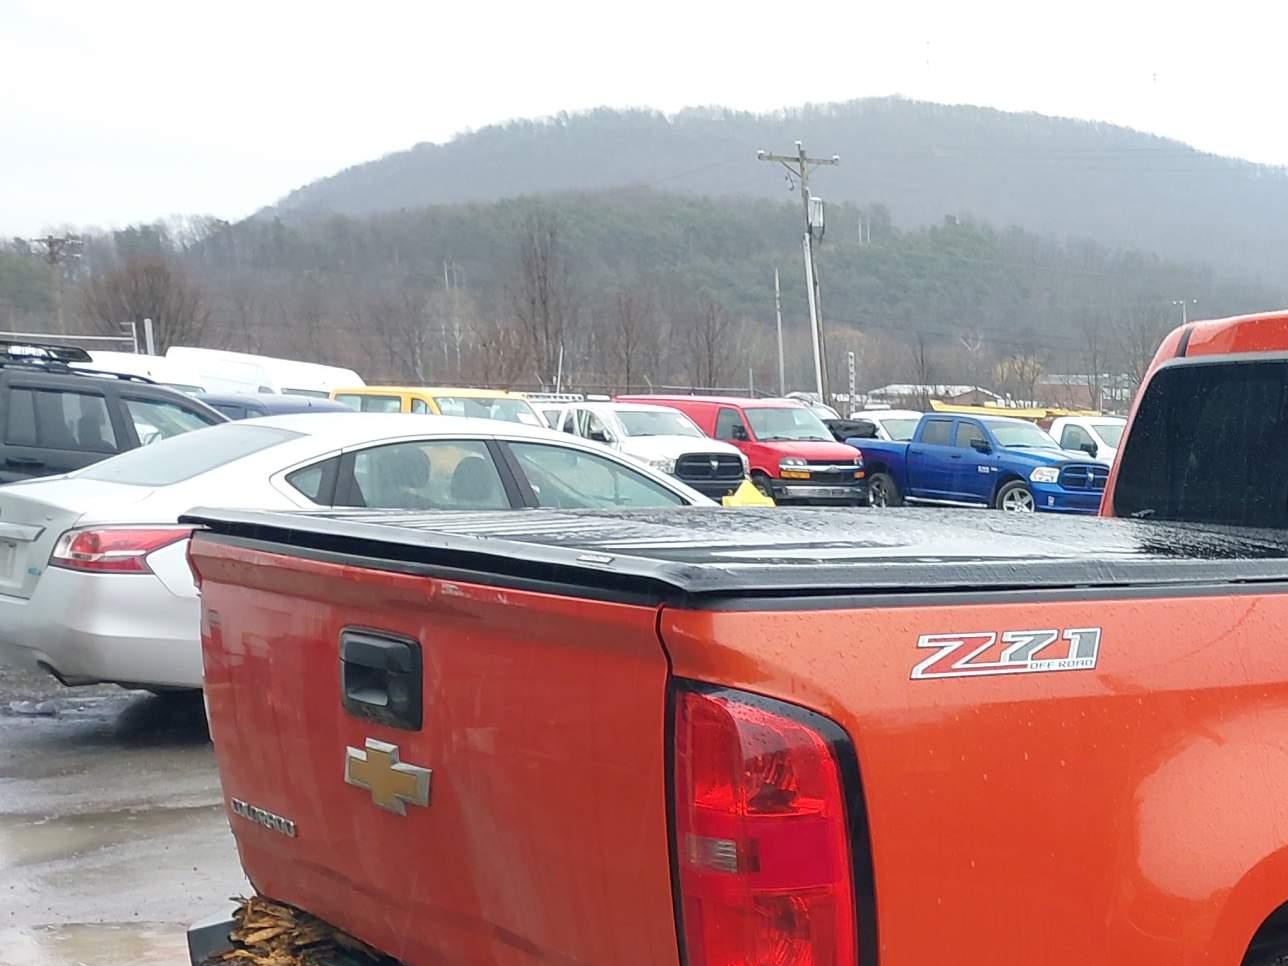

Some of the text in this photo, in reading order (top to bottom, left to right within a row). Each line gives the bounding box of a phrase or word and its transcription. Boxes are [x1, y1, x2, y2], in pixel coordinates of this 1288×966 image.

[910, 627, 1102, 680] Z71
[1030, 659, 1094, 670] OFF ROAD
